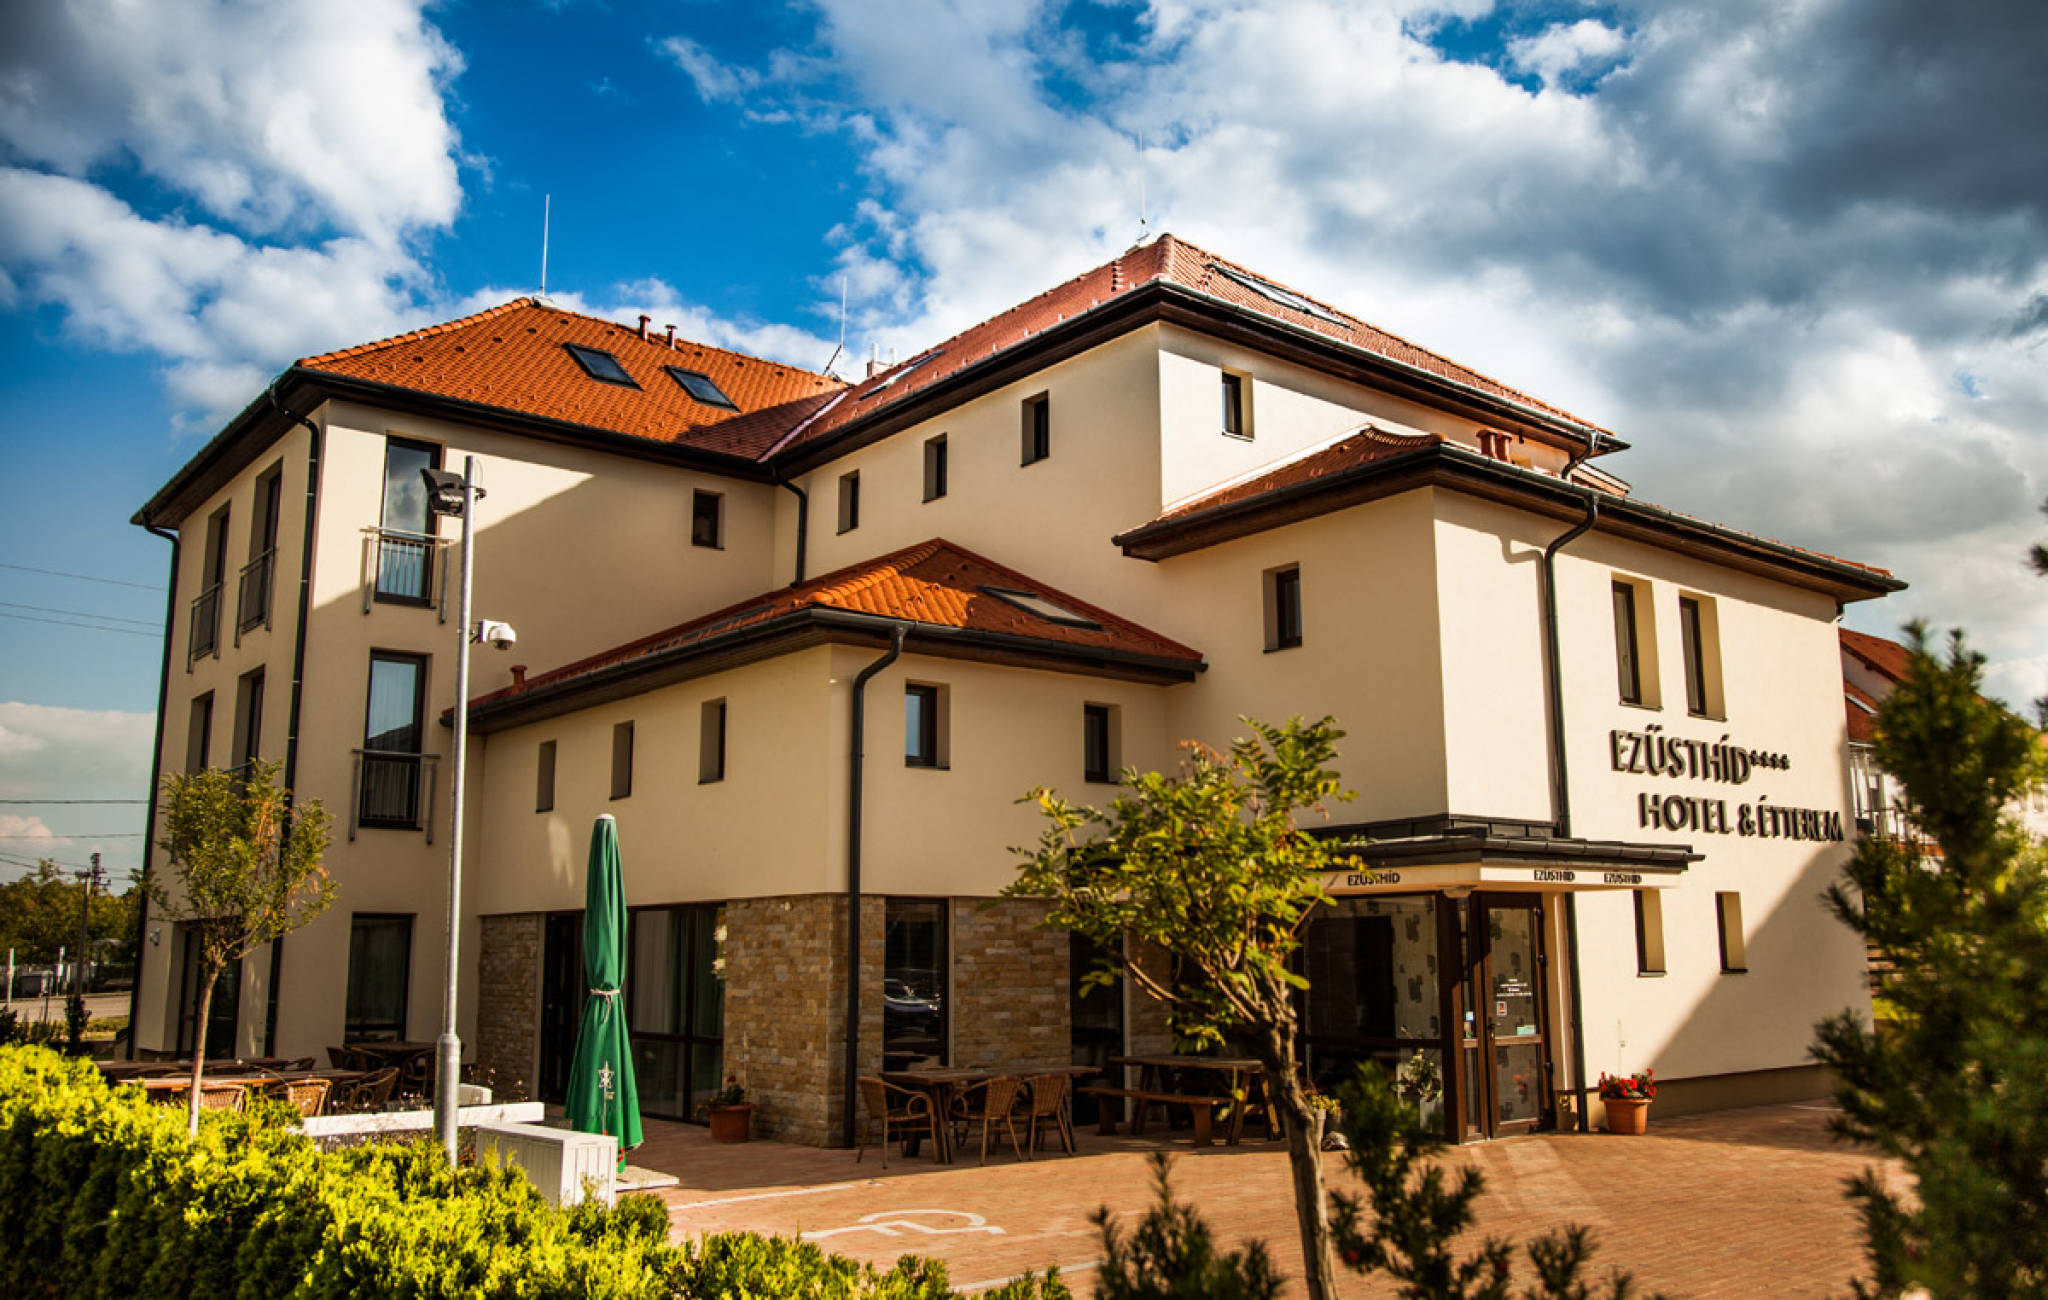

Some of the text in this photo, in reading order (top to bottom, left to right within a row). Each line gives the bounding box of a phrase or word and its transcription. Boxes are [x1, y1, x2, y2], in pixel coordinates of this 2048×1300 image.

[1638, 792, 1844, 841] HOTEL & ÉTTEREM
